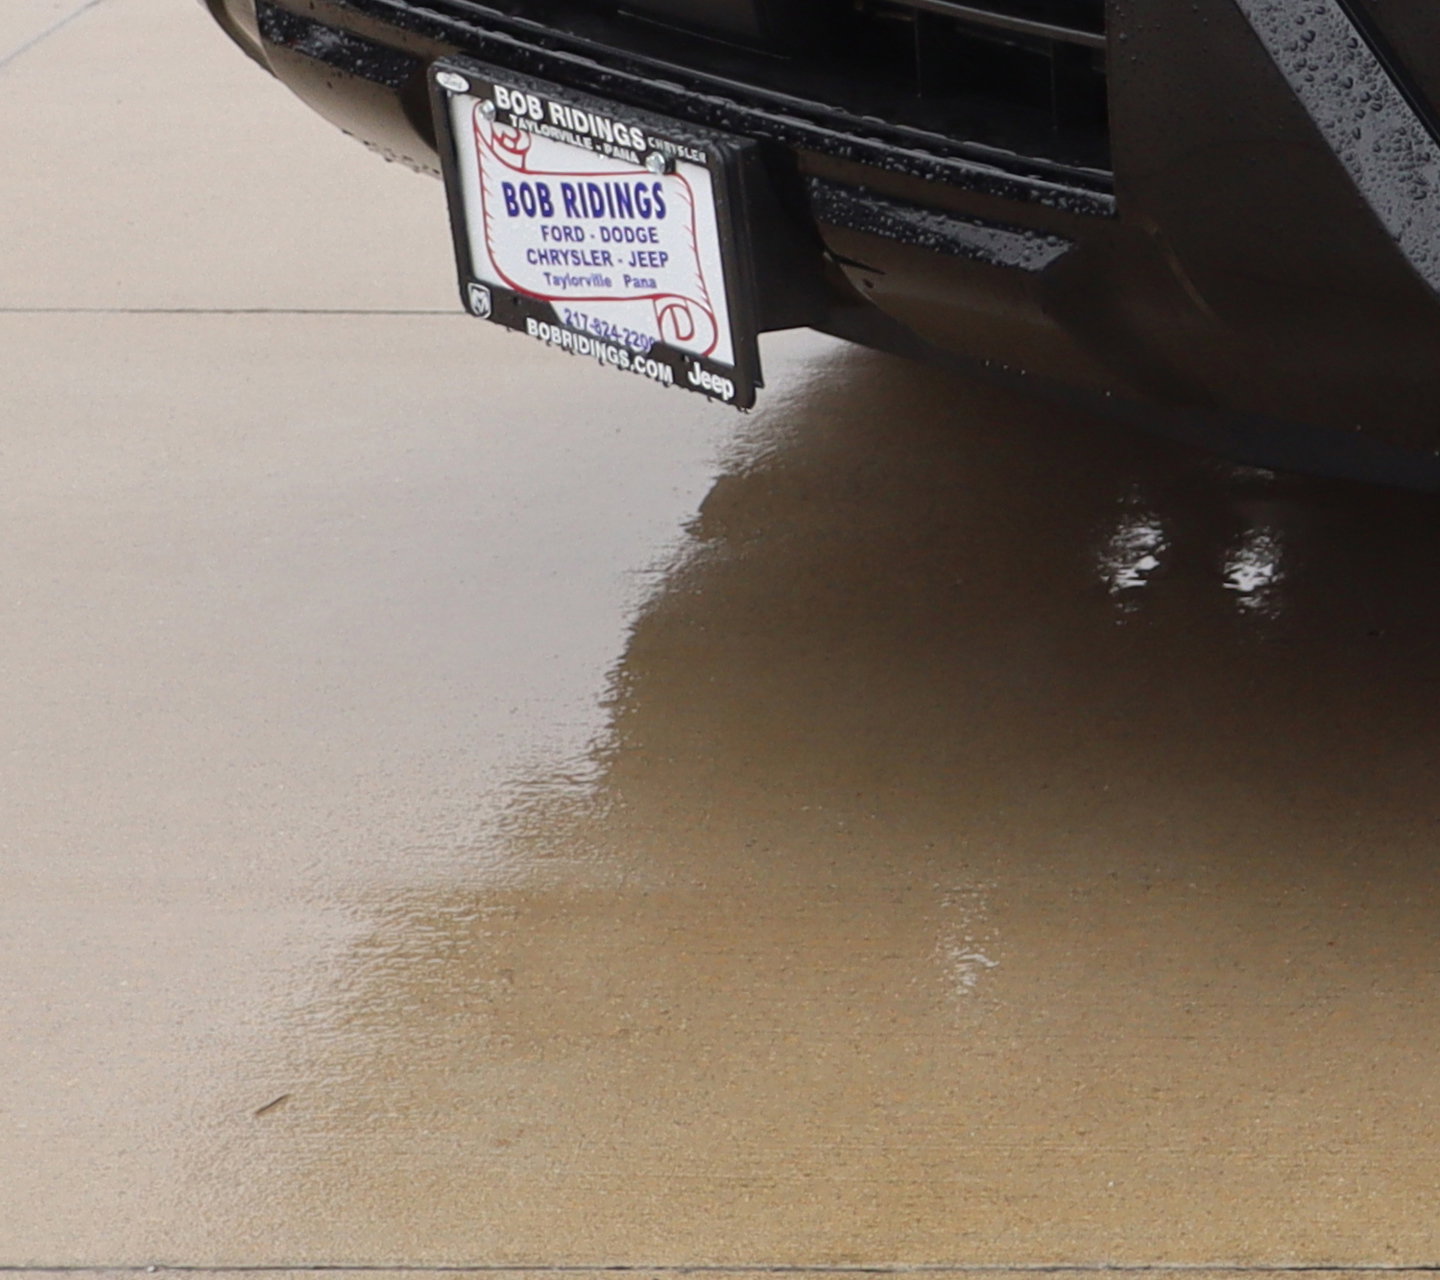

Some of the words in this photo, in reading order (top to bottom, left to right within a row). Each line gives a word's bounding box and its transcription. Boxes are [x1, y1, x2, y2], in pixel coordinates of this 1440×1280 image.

[493, 85, 544, 121] BOB
[549, 101, 647, 152] RIDINGS
[509, 113, 593, 151] TAYLORVILLE
[603, 143, 640, 165] PANA
[501, 181, 555, 218] BOB
[560, 181, 667, 220] RIDINGS
[541, 225, 585, 243] FORD
[600, 226, 660, 244] DODGE
[526, 248, 614, 267] CHRYSLER
[628, 251, 669, 269] JEEP
[543, 272, 612, 290] Taylorville
[623, 274, 658, 289] Pana
[526, 317, 674, 384] BOBRIDINGS.COM
[688, 361, 735, 401] Jeep
